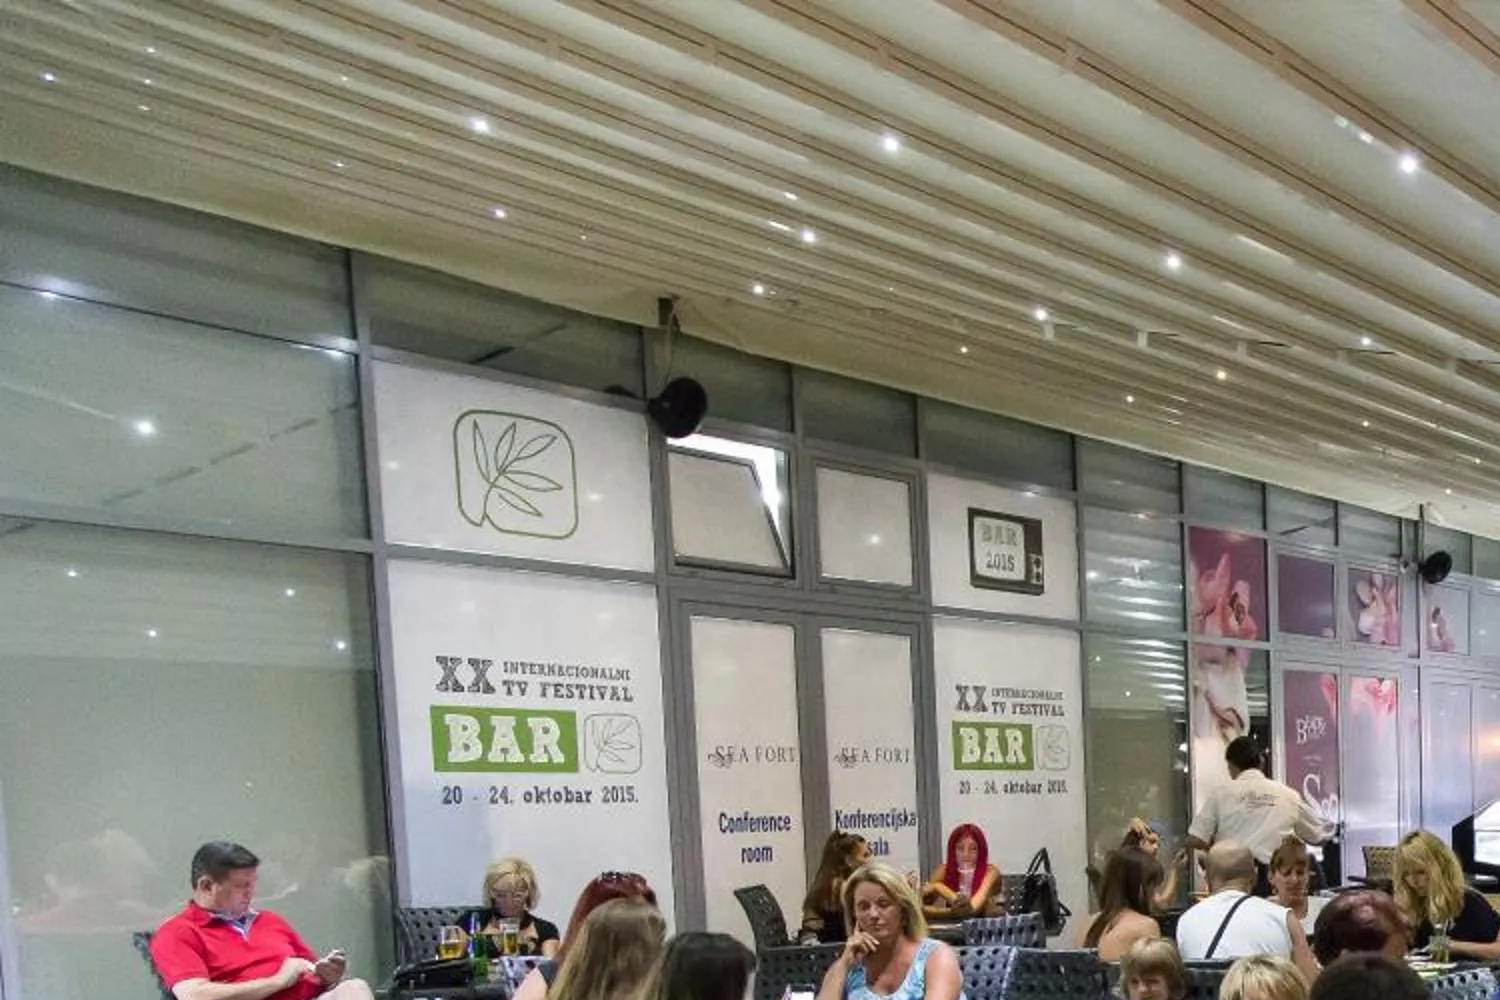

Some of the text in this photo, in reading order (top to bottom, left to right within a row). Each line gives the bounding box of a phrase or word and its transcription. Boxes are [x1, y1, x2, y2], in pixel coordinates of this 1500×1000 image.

[435, 656, 496, 694] XX
[503, 661, 631, 681] INTERNACIONALNI
[502, 680, 634, 702] TV FESTIVAL
[955, 684, 988, 712] XX
[992, 702, 1064, 716] TV FESTIVAL
[444, 714, 565, 763] BAR
[960, 727, 1027, 763] BAR
[756, 746, 796, 763] FORT
[875, 747, 910, 763] FORT
[442, 785, 463, 804] 20
[489, 785, 513, 804] 24.
[523, 785, 592, 803] oktobar
[601, 785, 639, 803] 2015.
[719, 811, 792, 833] Conference
[835, 808, 917, 832] Konferencijska
[741, 846, 773, 864] room
[867, 837, 889, 856] sala
